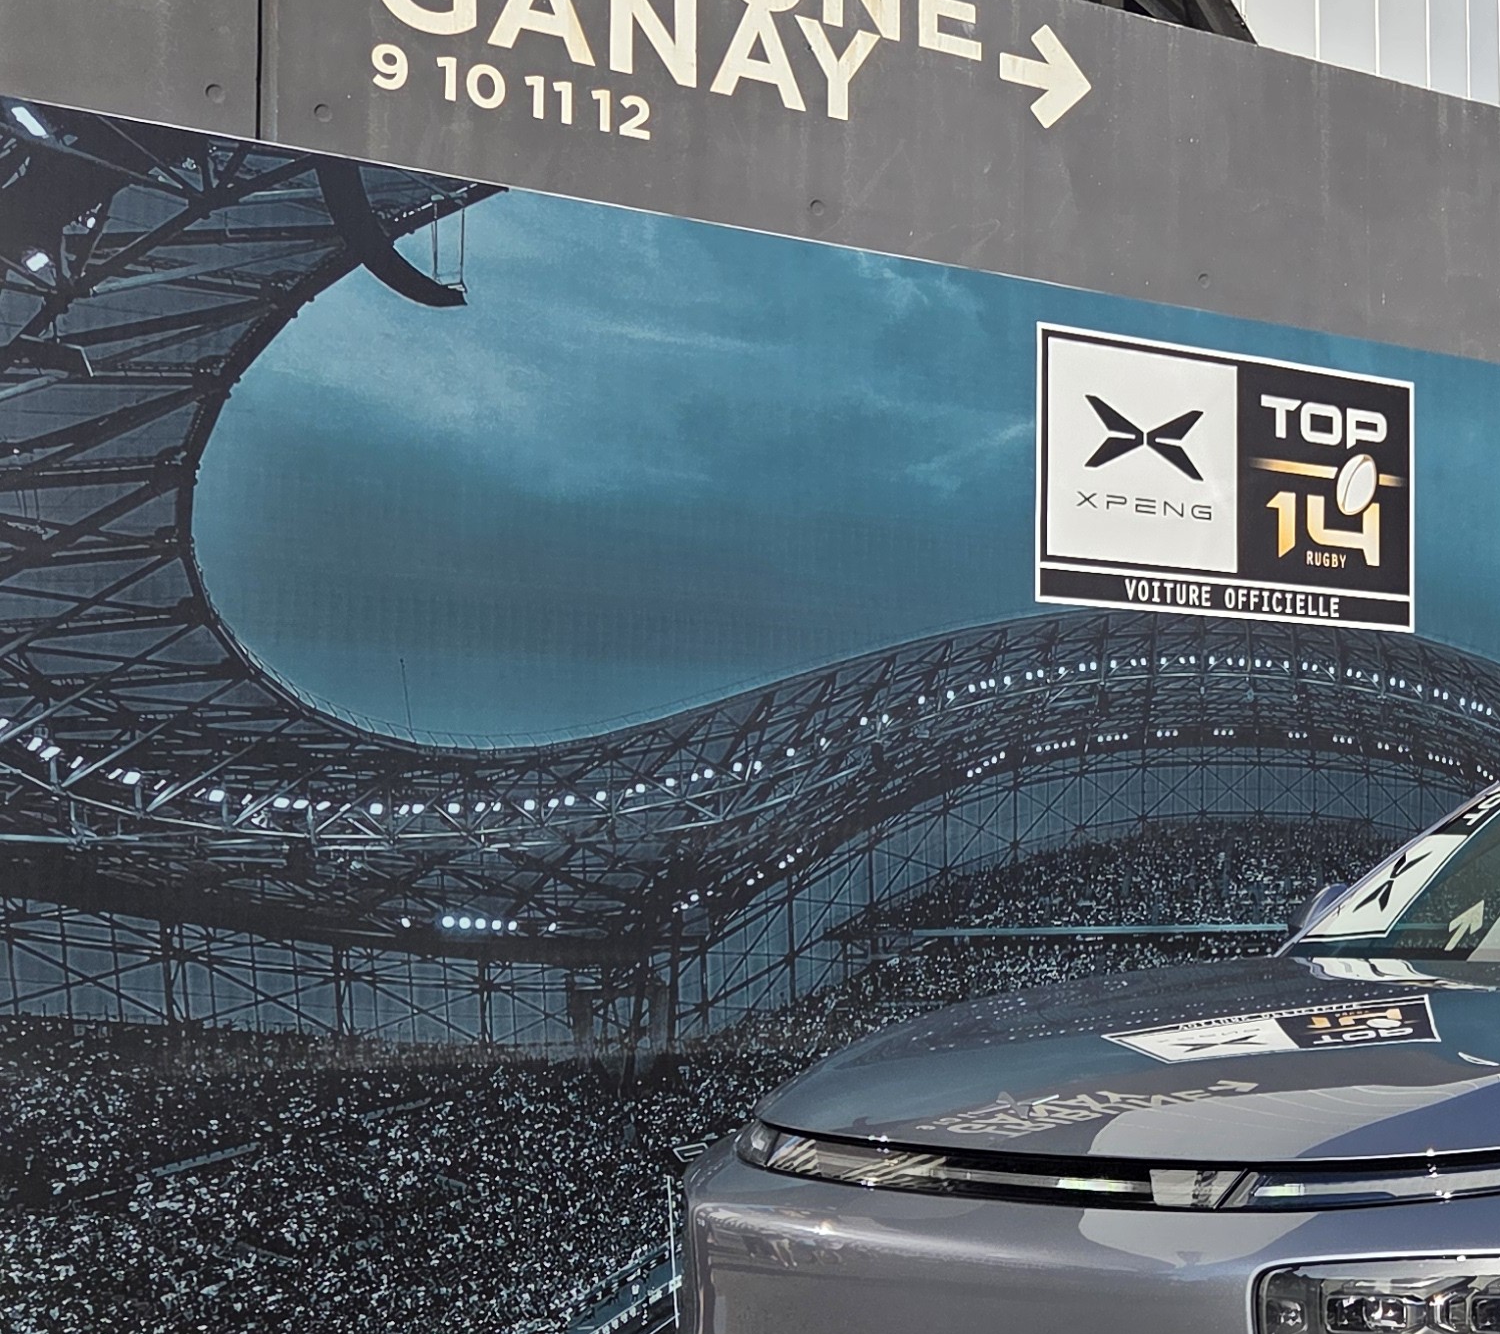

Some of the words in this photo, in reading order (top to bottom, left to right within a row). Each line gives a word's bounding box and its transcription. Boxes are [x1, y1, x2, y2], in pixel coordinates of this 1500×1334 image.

[370, 43, 408, 91] 9
[436, 55, 506, 110] 10
[525, 74, 574, 126] 11
[592, 88, 650, 140] 12
[1260, 394, 1388, 449] TOP
[1076, 490, 1213, 521] XPENG
[1266, 490, 1381, 567] 14
[1306, 550, 1347, 569] RUGBY
[1125, 578, 1212, 607] VOITURE
[1224, 588, 1340, 618] OFFICIELLE
